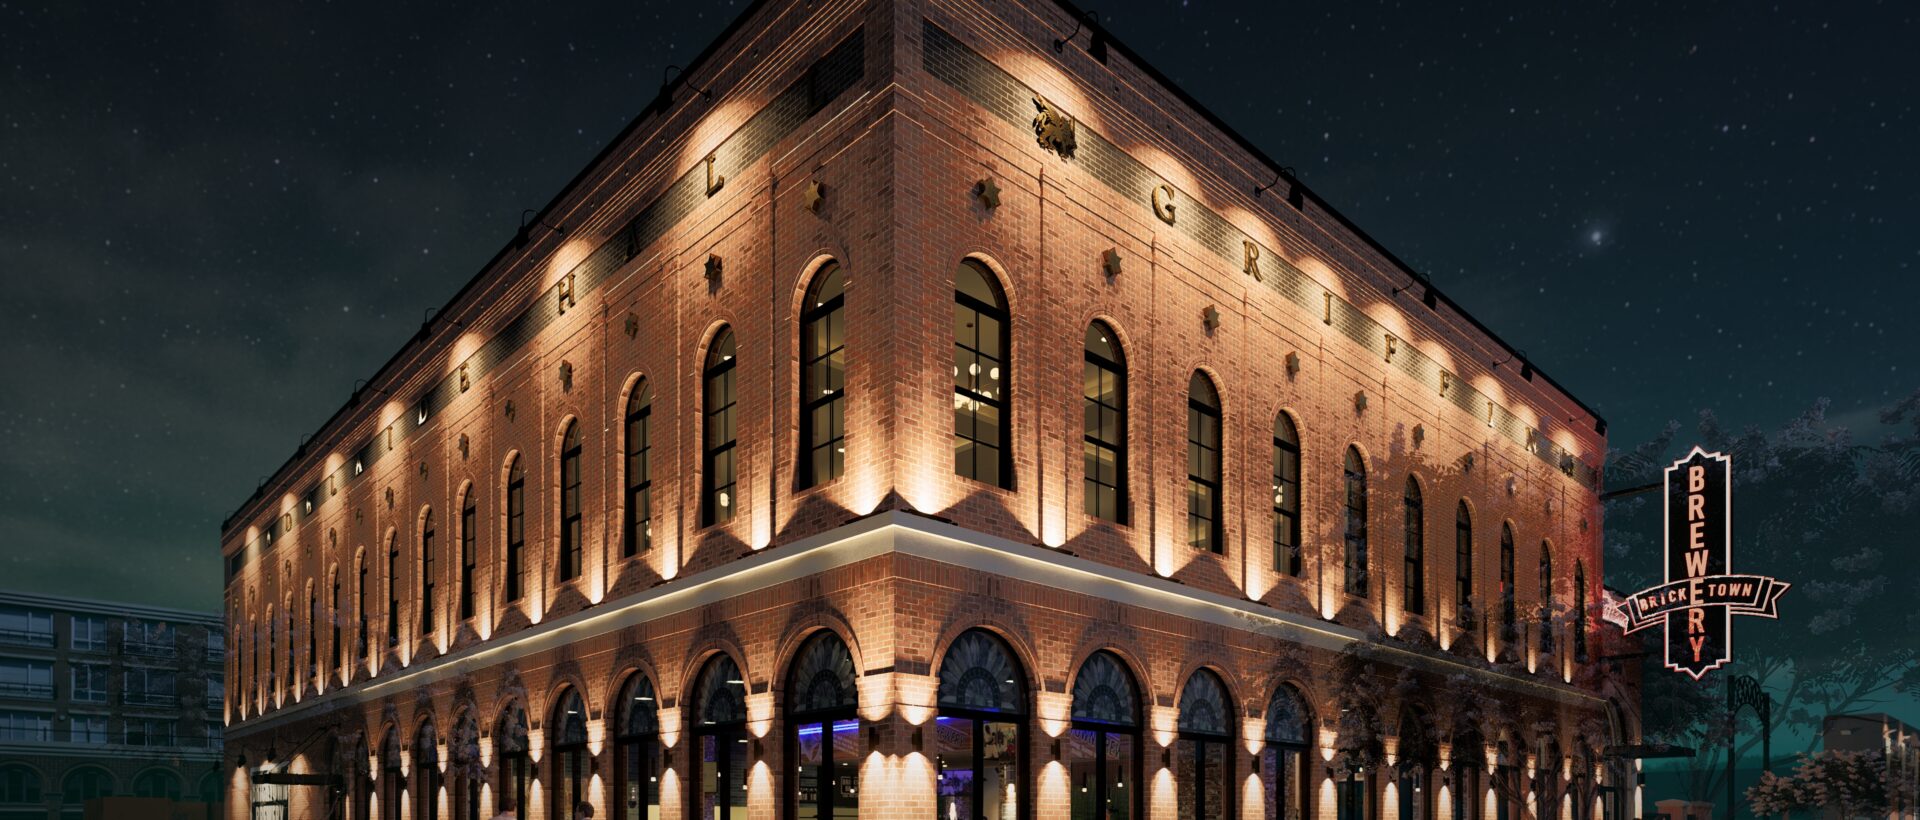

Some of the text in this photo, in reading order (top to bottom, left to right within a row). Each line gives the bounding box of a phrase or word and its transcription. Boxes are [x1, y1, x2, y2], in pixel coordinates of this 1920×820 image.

[1151, 184, 1537, 455] GRIFFIN
[1639, 582, 1752, 611] BRICK TOWN
[1685, 465, 1709, 662] BREWERY
